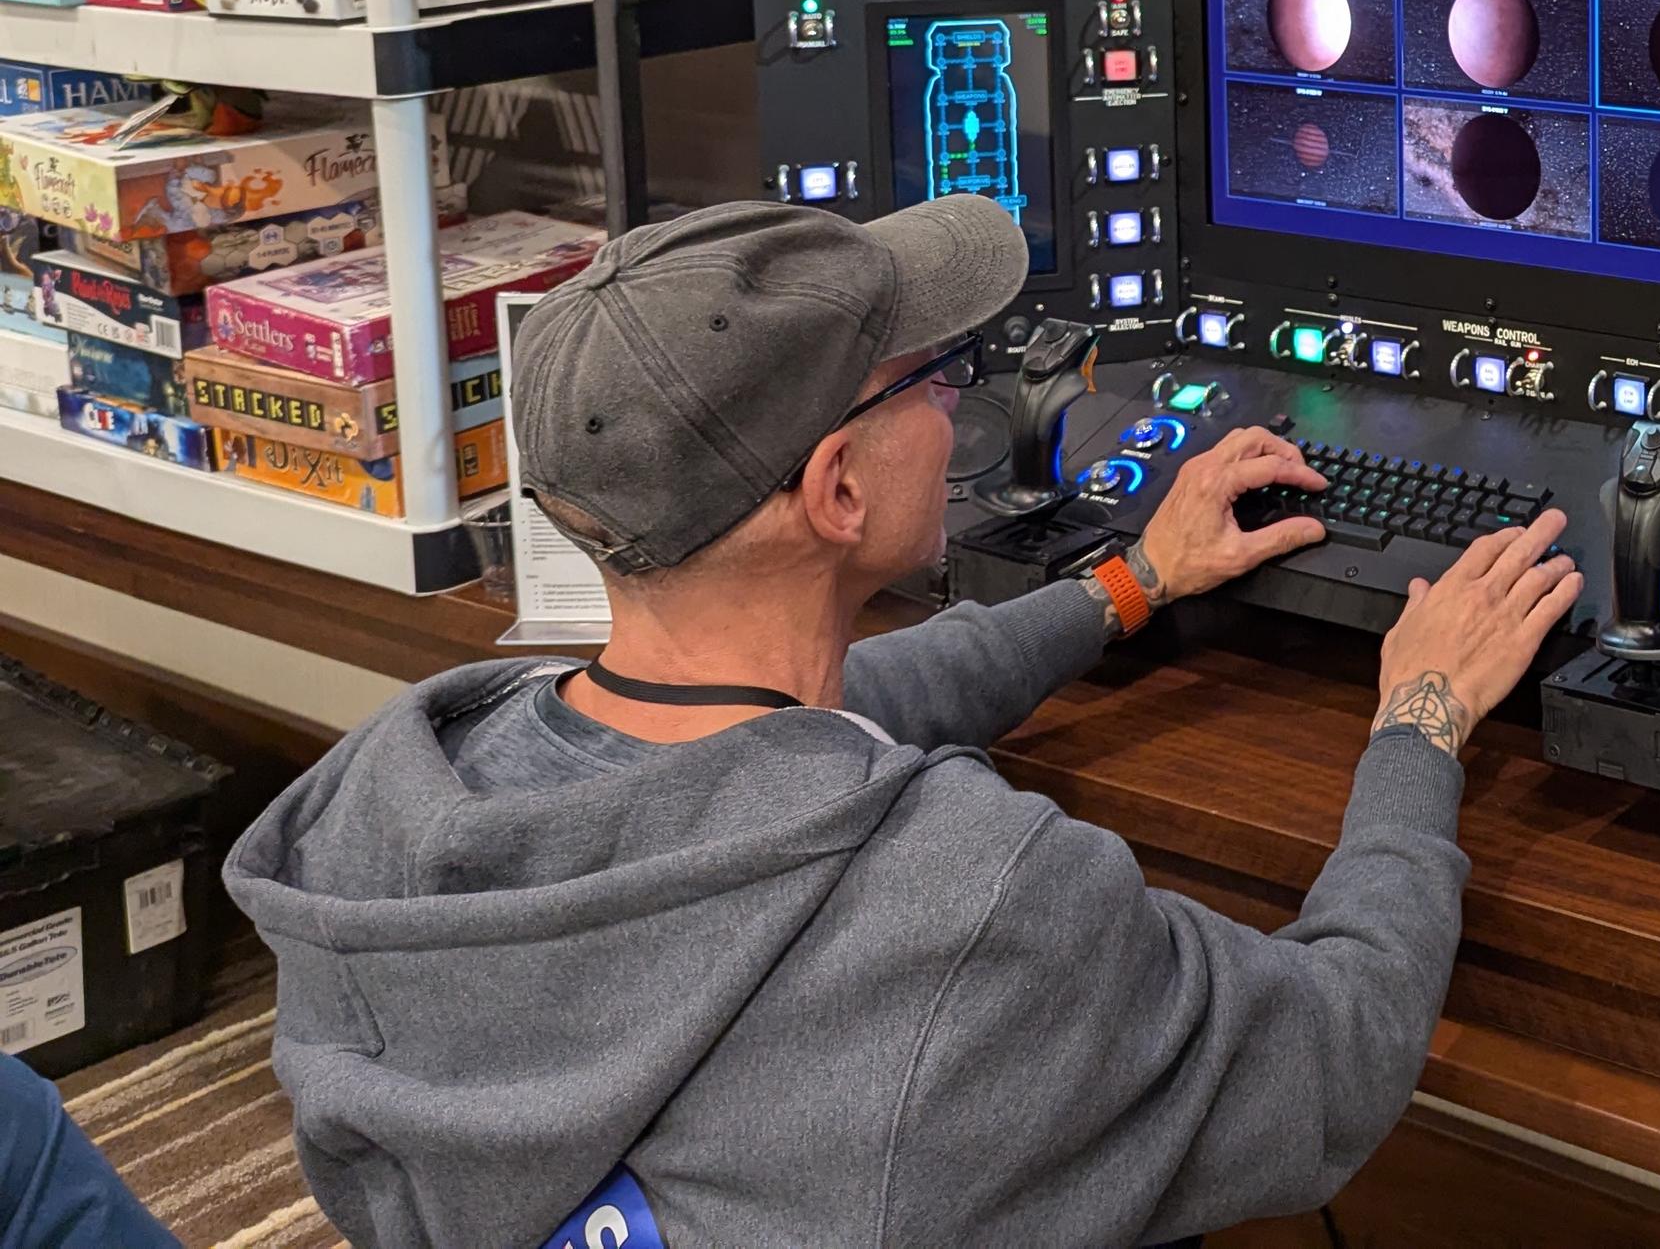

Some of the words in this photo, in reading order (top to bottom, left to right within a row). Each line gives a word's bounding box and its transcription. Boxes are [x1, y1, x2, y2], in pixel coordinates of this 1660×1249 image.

[63, 80, 140, 108] HAM
[233, 309, 294, 352] Settlers
[1442, 320, 1490, 337] WEAPONS
[1496, 328, 1540, 345] CONTROL
[1626, 358, 1639, 366] ECM
[195, 379, 321, 428] STACKED
